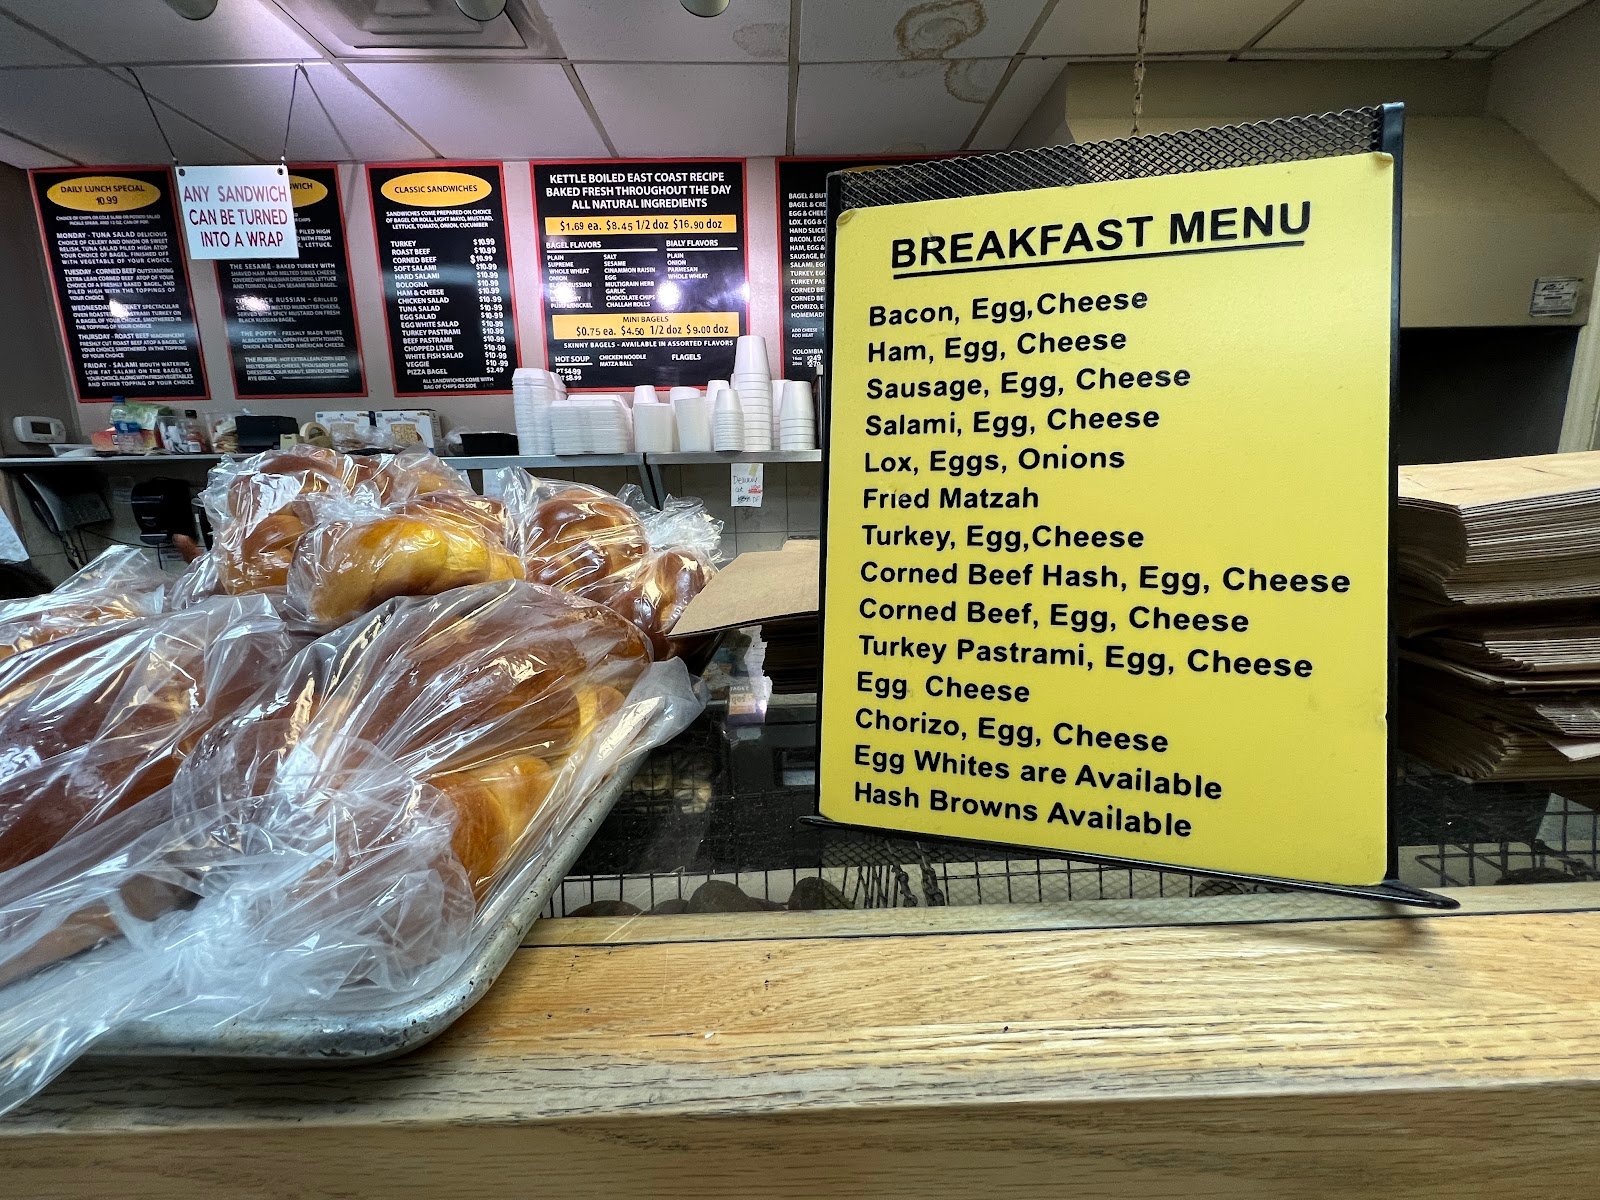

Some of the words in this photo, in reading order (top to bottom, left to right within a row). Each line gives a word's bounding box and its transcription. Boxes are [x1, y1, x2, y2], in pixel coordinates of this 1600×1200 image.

[550, 174, 587, 184] KETTLE
[588, 173, 626, 183] BOILED
[627, 173, 653, 182] EAST
[654, 172, 688, 182] COAST
[690, 172, 725, 181] RECIPE
[60, 185, 83, 193] DAILY
[113, 184, 145, 192] SPECIAL
[184, 186, 210, 202] ANY
[217, 186, 288, 202] SANDWICH
[427, 184, 478, 193] SANDWICHES
[546, 187, 580, 197] BAKED
[582, 186, 614, 197] FRESH
[615, 185, 687, 196] THROUGHOUT
[689, 185, 709, 195] THE
[711, 184, 732, 194] DAY
[96, 196, 118, 205] 10.99
[571, 200, 591, 210] ALL
[592, 199, 639, 209] NATURAL
[641, 198, 708, 208] INGREDIENTS
[189, 209, 218, 225] CAN
[220, 209, 236, 225] BE
[237, 209, 288, 225] TURNED
[587, 222, 602, 231] ea.
[606, 220, 633, 231] $8.45
[636, 219, 651, 230] 1/2
[652, 219, 669, 230] doz
[706, 218, 722, 229] doz
[200, 231, 230, 247] INTO
[234, 231, 244, 247] A
[246, 231, 283, 247] WRAP
[666, 239, 686, 247] BIALY
[892, 215, 1154, 269] BREAKFAST
[1169, 200, 1311, 245] MENU
[570, 241, 602, 249] FLAVORS
[641, 315, 669, 323] BAGELS
[870, 306, 960, 327] Bacon,
[576, 327, 601, 337] $0.75
[603, 327, 616, 336] ea.
[621, 326, 645, 336] $4.50
[650, 325, 664, 335] 1/2
[666, 324, 682, 334] doz
[713, 323, 729, 334] doz
[671, 353, 702, 361] FLAGELS
[868, 341, 934, 365] Ham,
[944, 336, 1006, 364] Egg,
[1017, 331, 1127, 355] Cheese
[867, 378, 989, 402] Sausage,
[1001, 371, 1064, 399] Egg,
[1076, 367, 1191, 391] Cheese
[865, 413, 962, 437] Salami,
[973, 410, 1035, 438] Egg,
[1047, 408, 1160, 431] Cheese
[865, 452, 919, 476] Lox,
[930, 450, 1007, 477] Eggs,
[1018, 445, 1125, 470] Onions
[863, 487, 930, 509] Fried
[939, 486, 1039, 509] Matzah
[861, 524, 956, 552] Turkey,
[860, 561, 958, 585] Corned
[968, 563, 1034, 586] Beef
[1042, 564, 1127, 592] Hash,
[1139, 565, 1210, 596] Egg,
[1222, 566, 1351, 593] Cheese
[859, 597, 957, 622] Corned
[967, 601, 1039, 629] Beef,
[1050, 603, 1116, 634] Egg,
[1128, 605, 1249, 633] Cheese
[858, 634, 947, 665] Turkey
[957, 638, 1093, 671] Pastrami,
[1105, 645, 1174, 677] Egg,
[1187, 648, 1313, 678] Cheese
[857, 670, 907, 701] Egg
[925, 675, 1030, 703] Cheese
[855, 707, 967, 741] Chorizo,
[978, 716, 1041, 748] Egg,
[1053, 722, 1169, 753] Cheese
[854, 744, 905, 775] Egg
[913, 749, 1010, 780] Whites
[1020, 764, 1067, 785] are
[1074, 764, 1222, 800] Available
[854, 781, 919, 809] Hash
[930, 789, 1038, 822] Browns
[1046, 801, 1192, 838] Available
